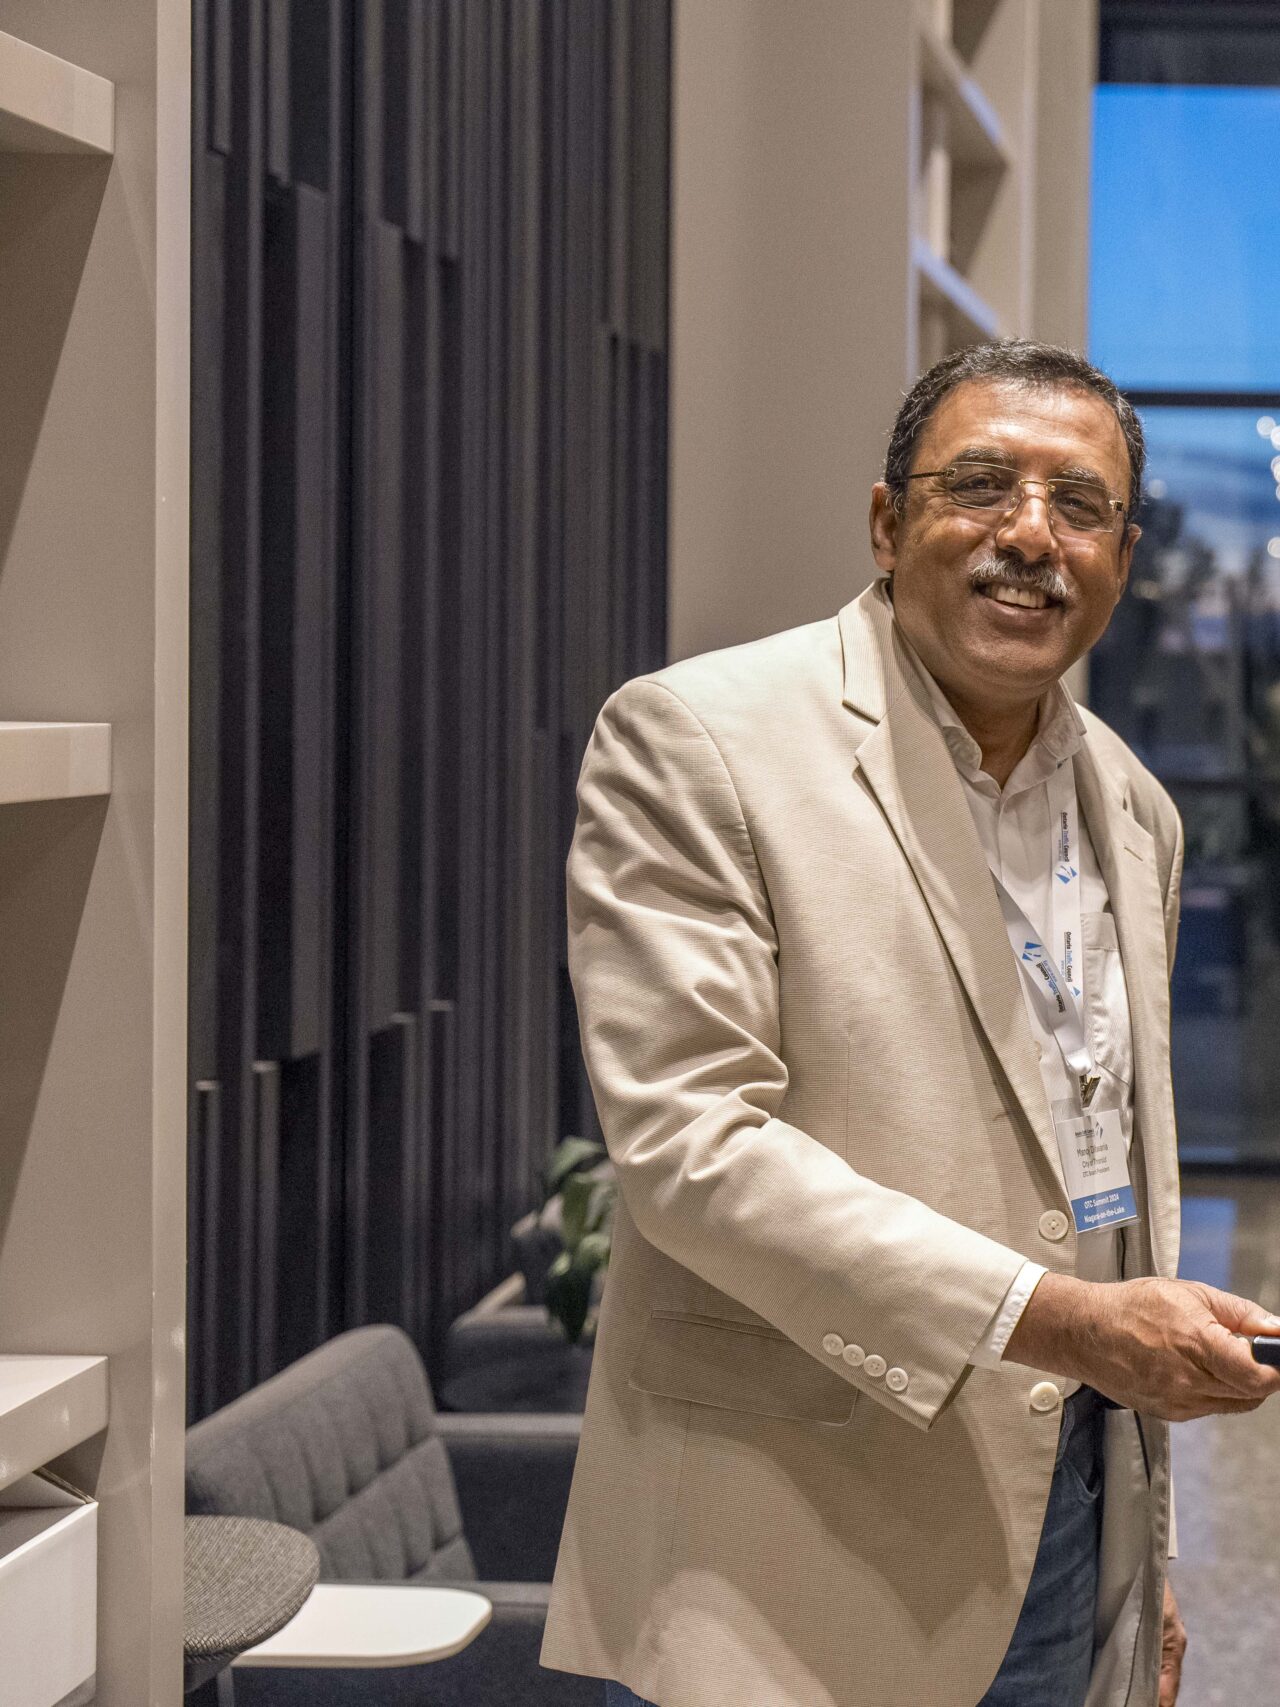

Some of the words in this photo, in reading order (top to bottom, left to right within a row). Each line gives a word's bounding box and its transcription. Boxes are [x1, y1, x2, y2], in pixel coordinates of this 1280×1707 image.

[1084, 1200, 1093, 1209] OTC
[1093, 1196, 1109, 1207] Summit
[1109, 1193, 1119, 1203] 2024
